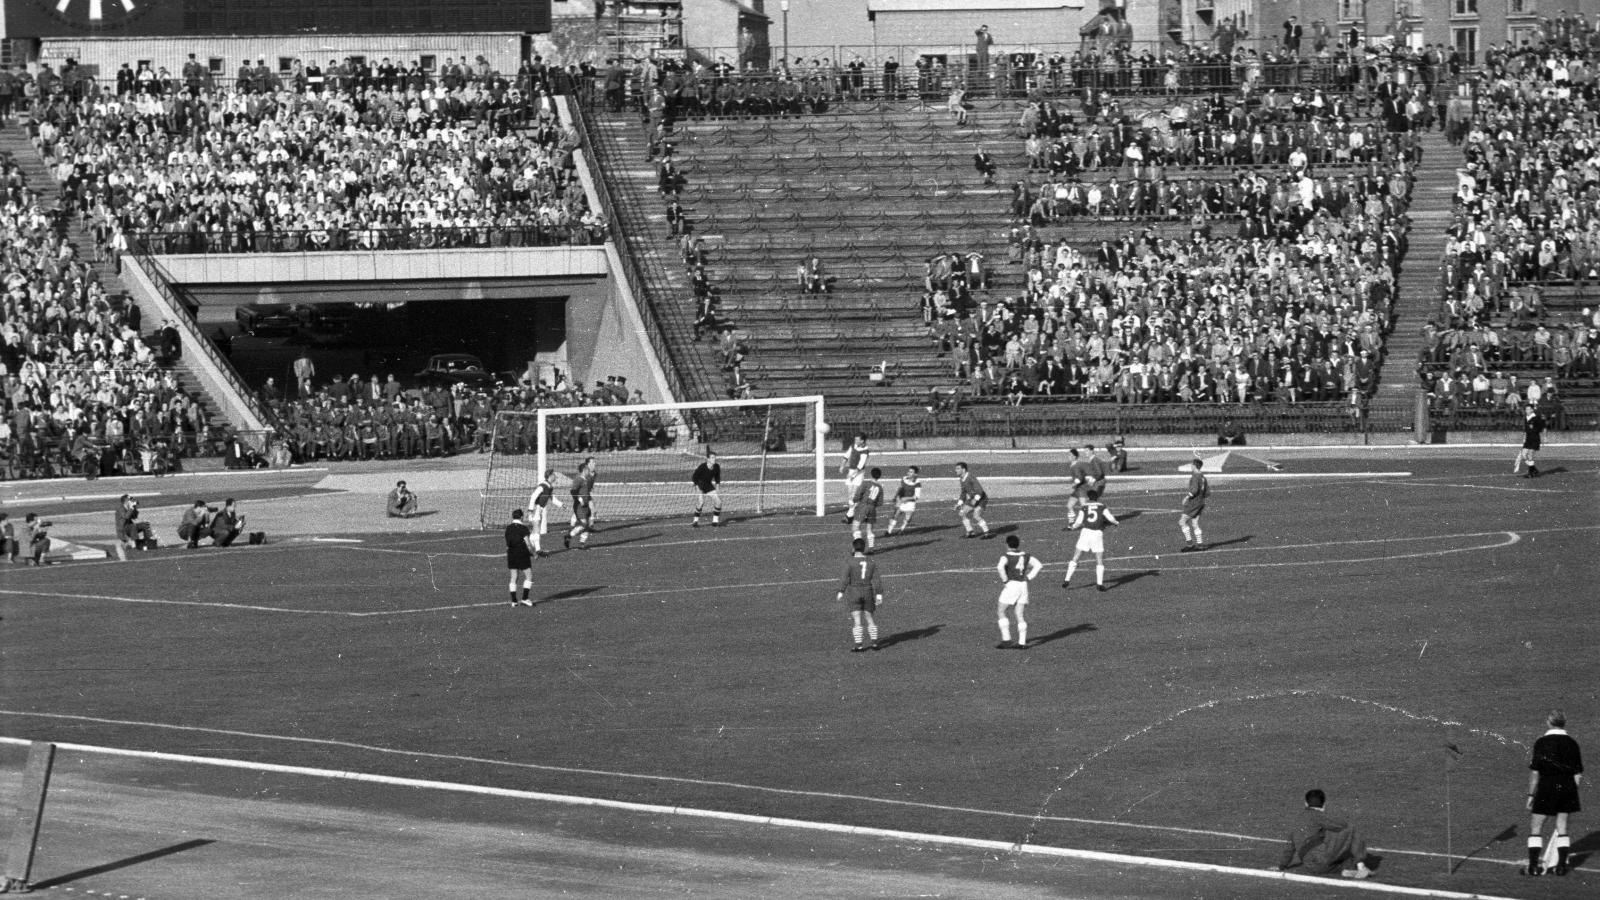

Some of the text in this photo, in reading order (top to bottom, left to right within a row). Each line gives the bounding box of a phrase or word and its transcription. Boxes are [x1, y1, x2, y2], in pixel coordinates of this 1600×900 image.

[869, 485, 880, 500] 10
[1087, 505, 1098, 523] 5
[859, 561, 867, 580] 7
[1015, 555, 1025, 576] 4
